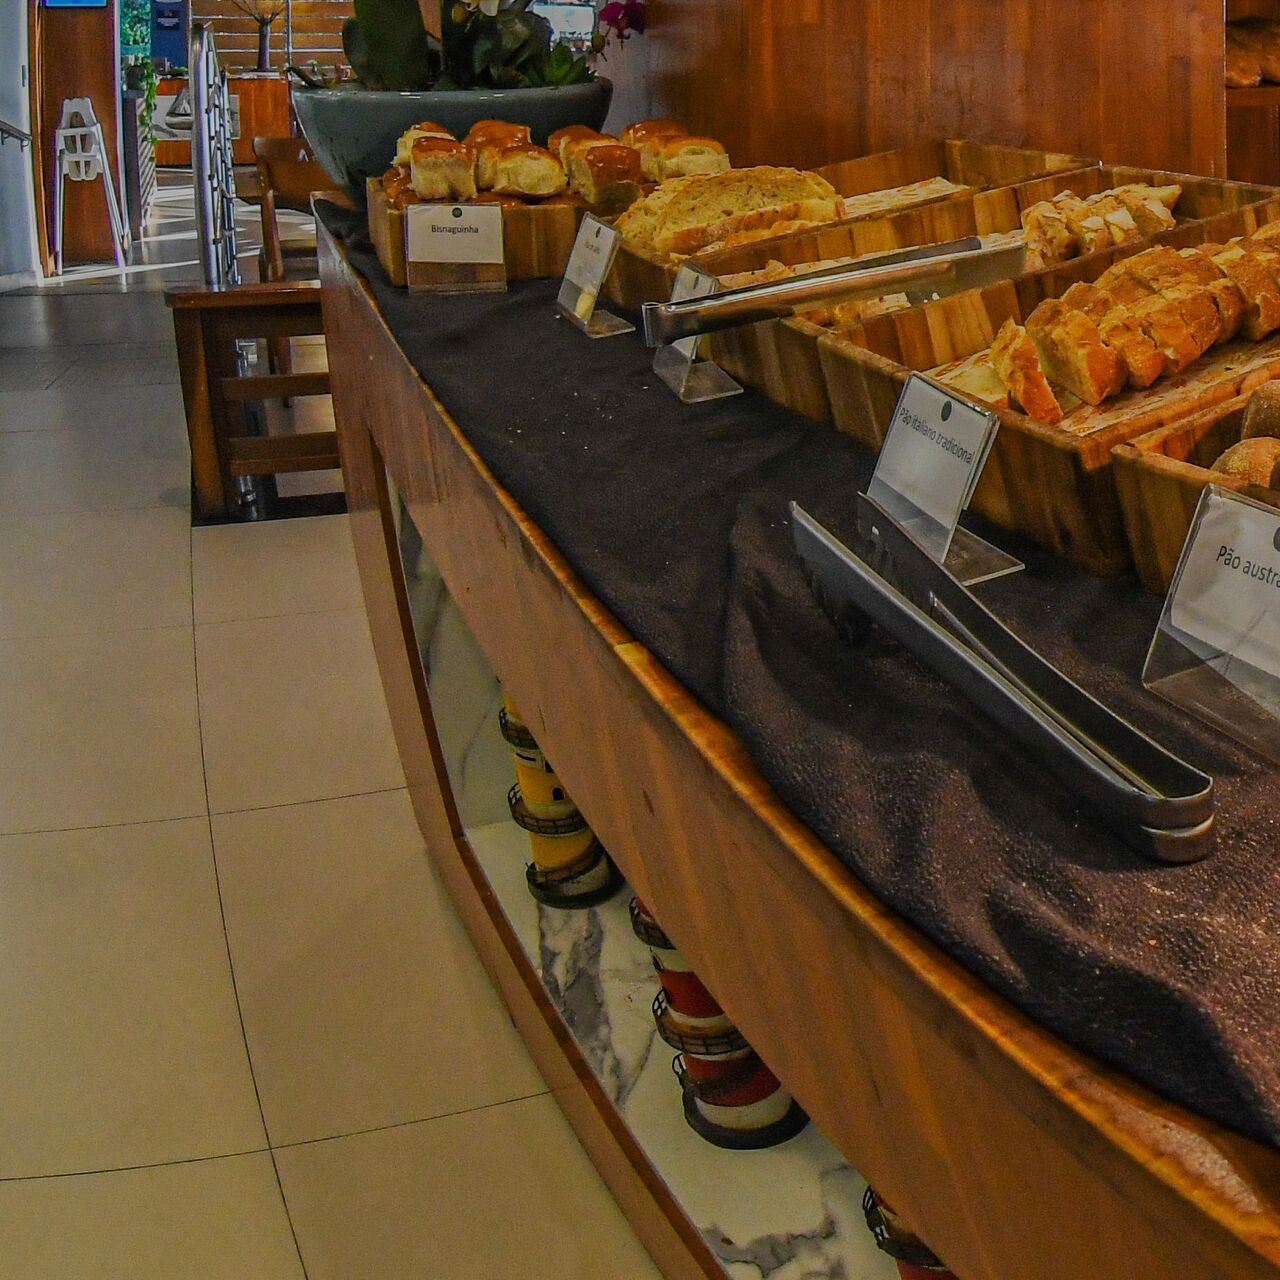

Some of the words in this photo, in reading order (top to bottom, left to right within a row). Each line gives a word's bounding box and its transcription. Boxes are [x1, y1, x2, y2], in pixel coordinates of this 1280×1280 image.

[431, 225, 479, 234] Bisnaguinha
[899, 407, 912, 425] Pão
[1216, 545, 1241, 570] Pão
